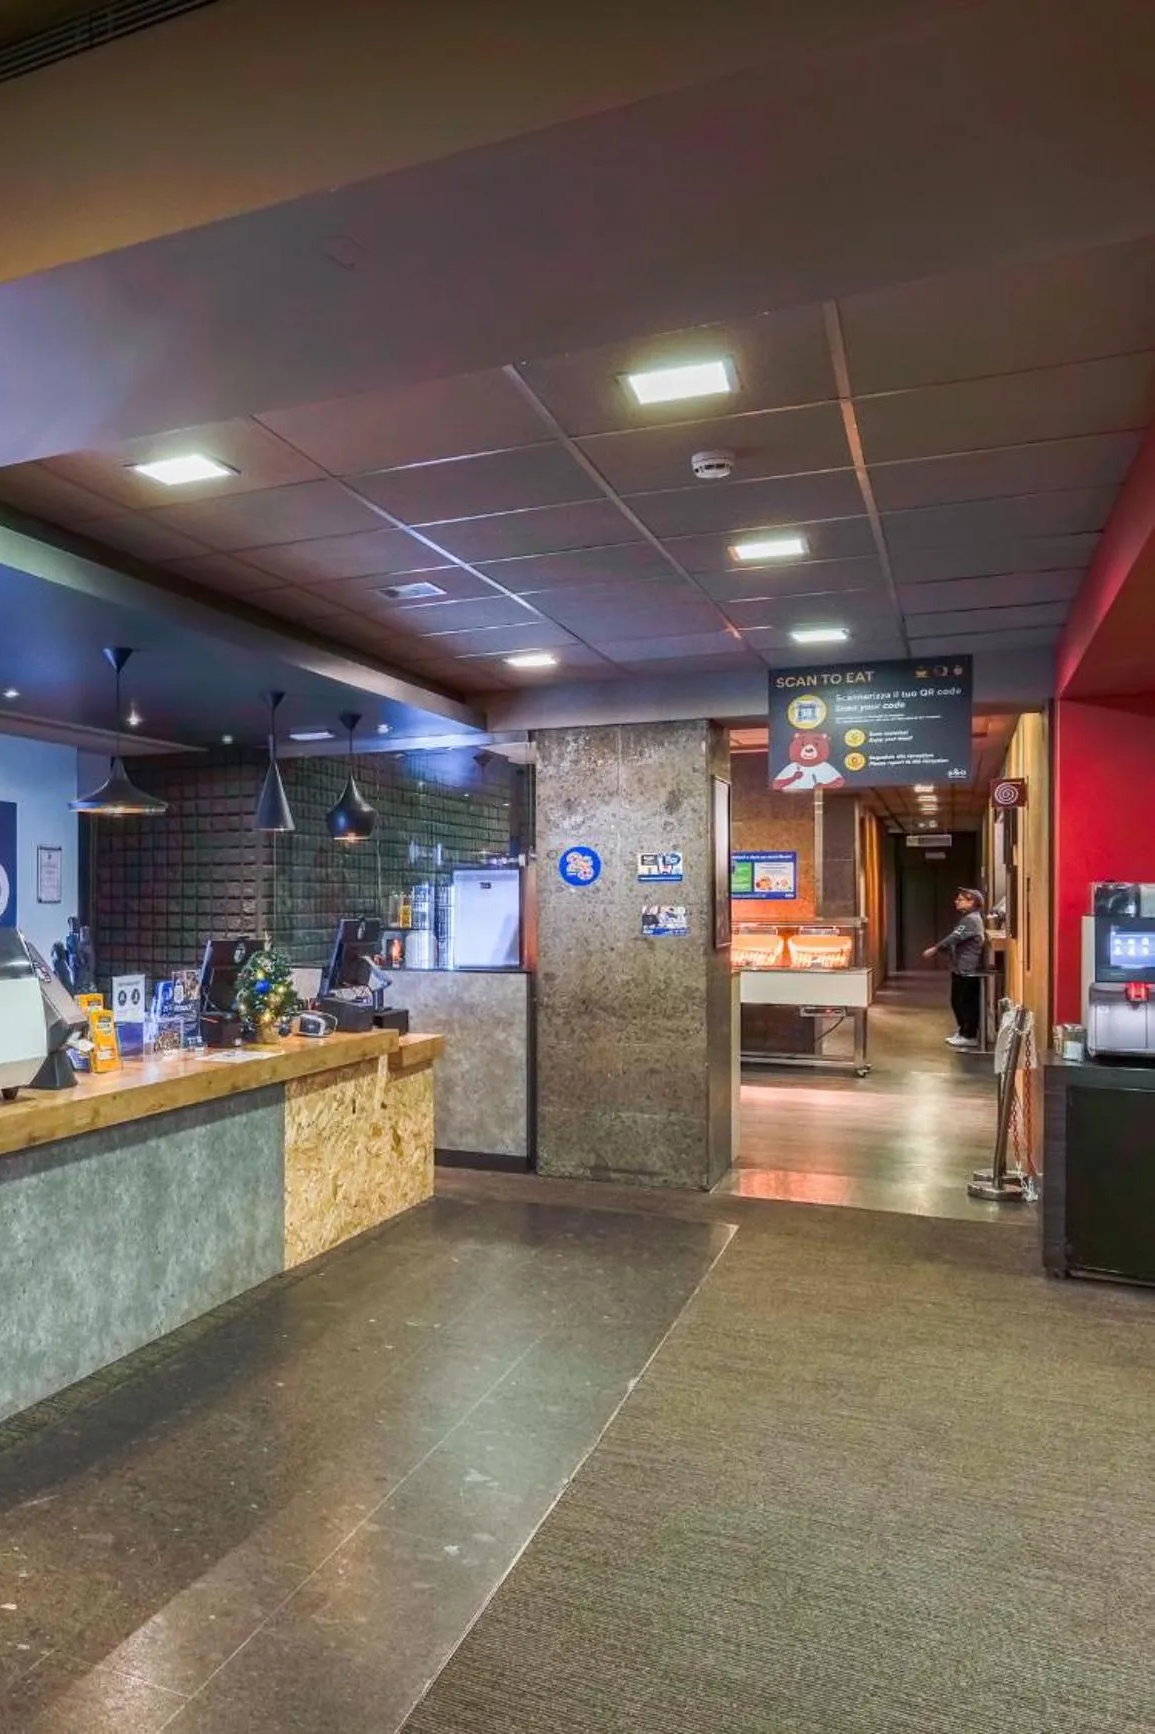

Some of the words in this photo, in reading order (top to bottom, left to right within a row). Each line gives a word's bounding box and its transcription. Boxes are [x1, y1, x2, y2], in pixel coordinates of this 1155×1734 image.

[776, 675, 817, 688] SCAN
[821, 673, 842, 684] TO
[846, 671, 875, 683] EAT
[901, 689, 917, 698] tuo
[920, 688, 934, 697] QR
[937, 686, 962, 695] code
[883, 700, 906, 709] code
